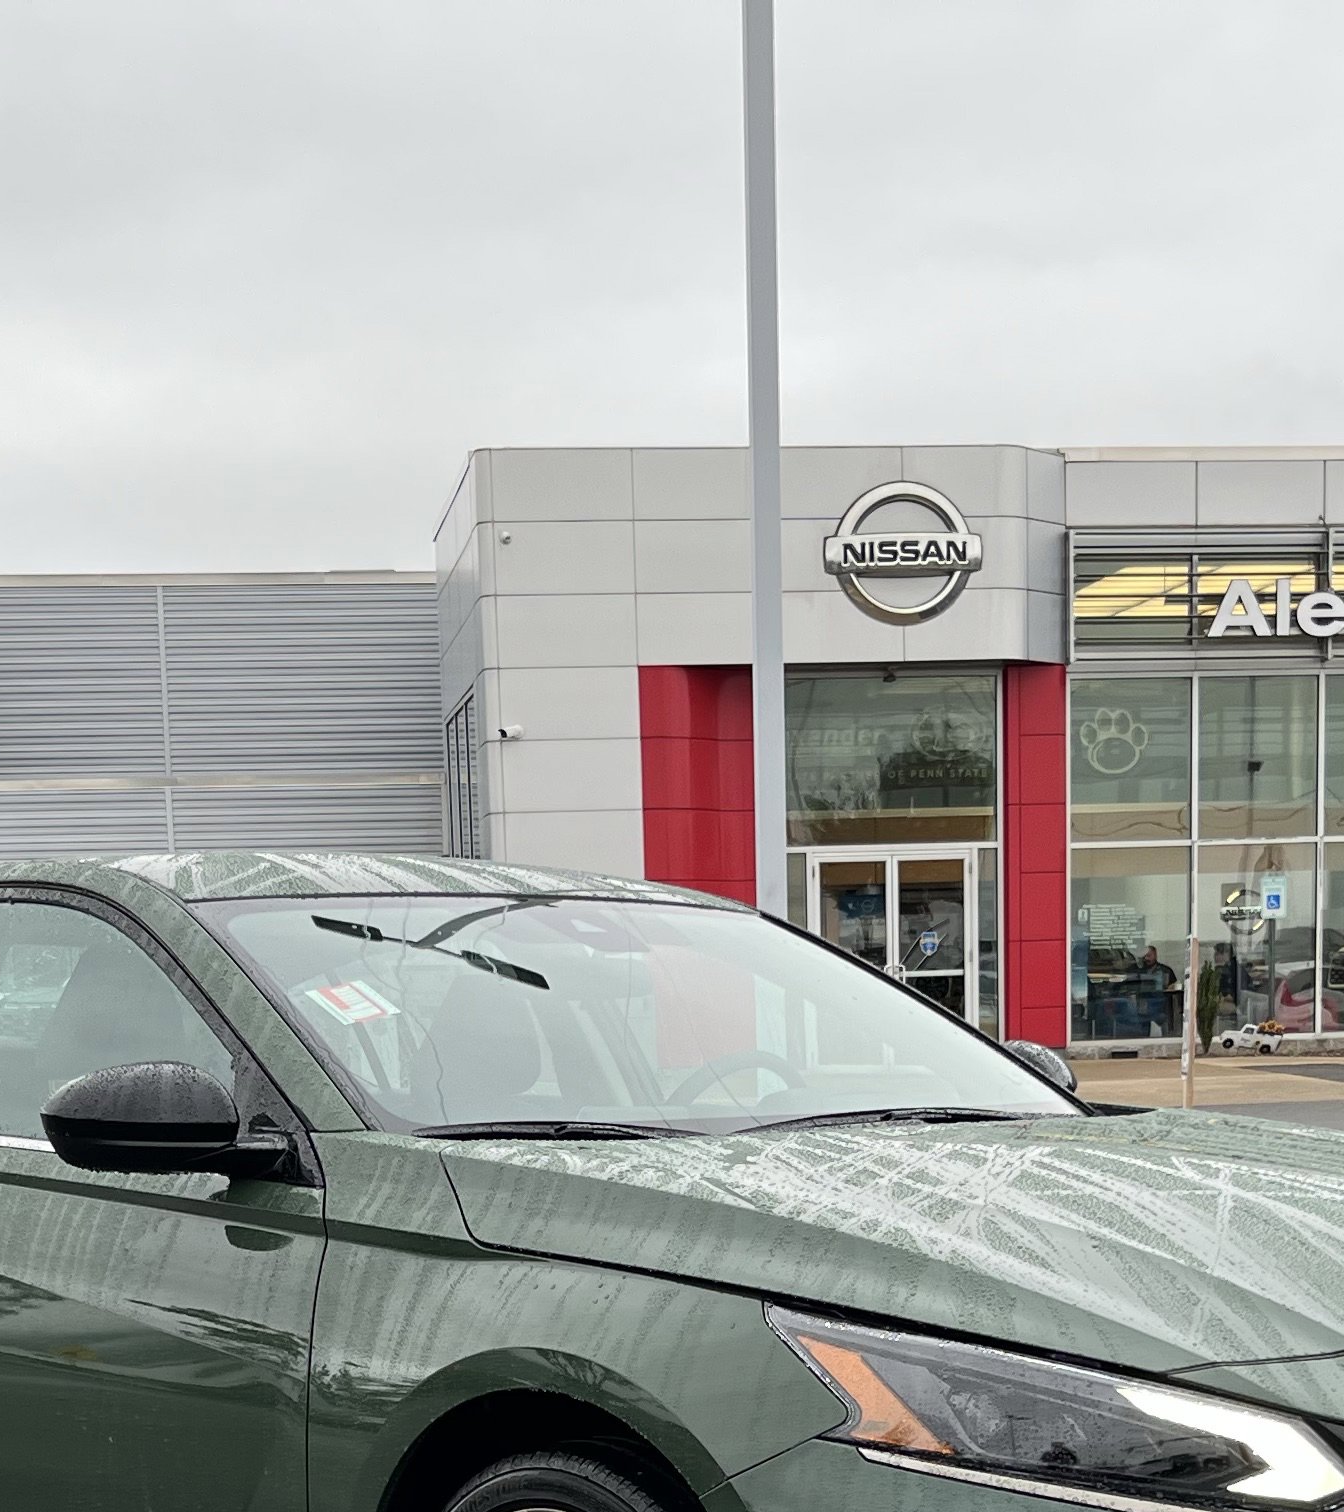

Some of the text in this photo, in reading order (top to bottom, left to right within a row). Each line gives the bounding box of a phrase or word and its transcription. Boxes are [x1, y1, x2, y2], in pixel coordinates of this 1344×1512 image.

[842, 540, 968, 565] NISSAN
[910, 768, 944, 778] PENN
[949, 768, 988, 778] STATE
